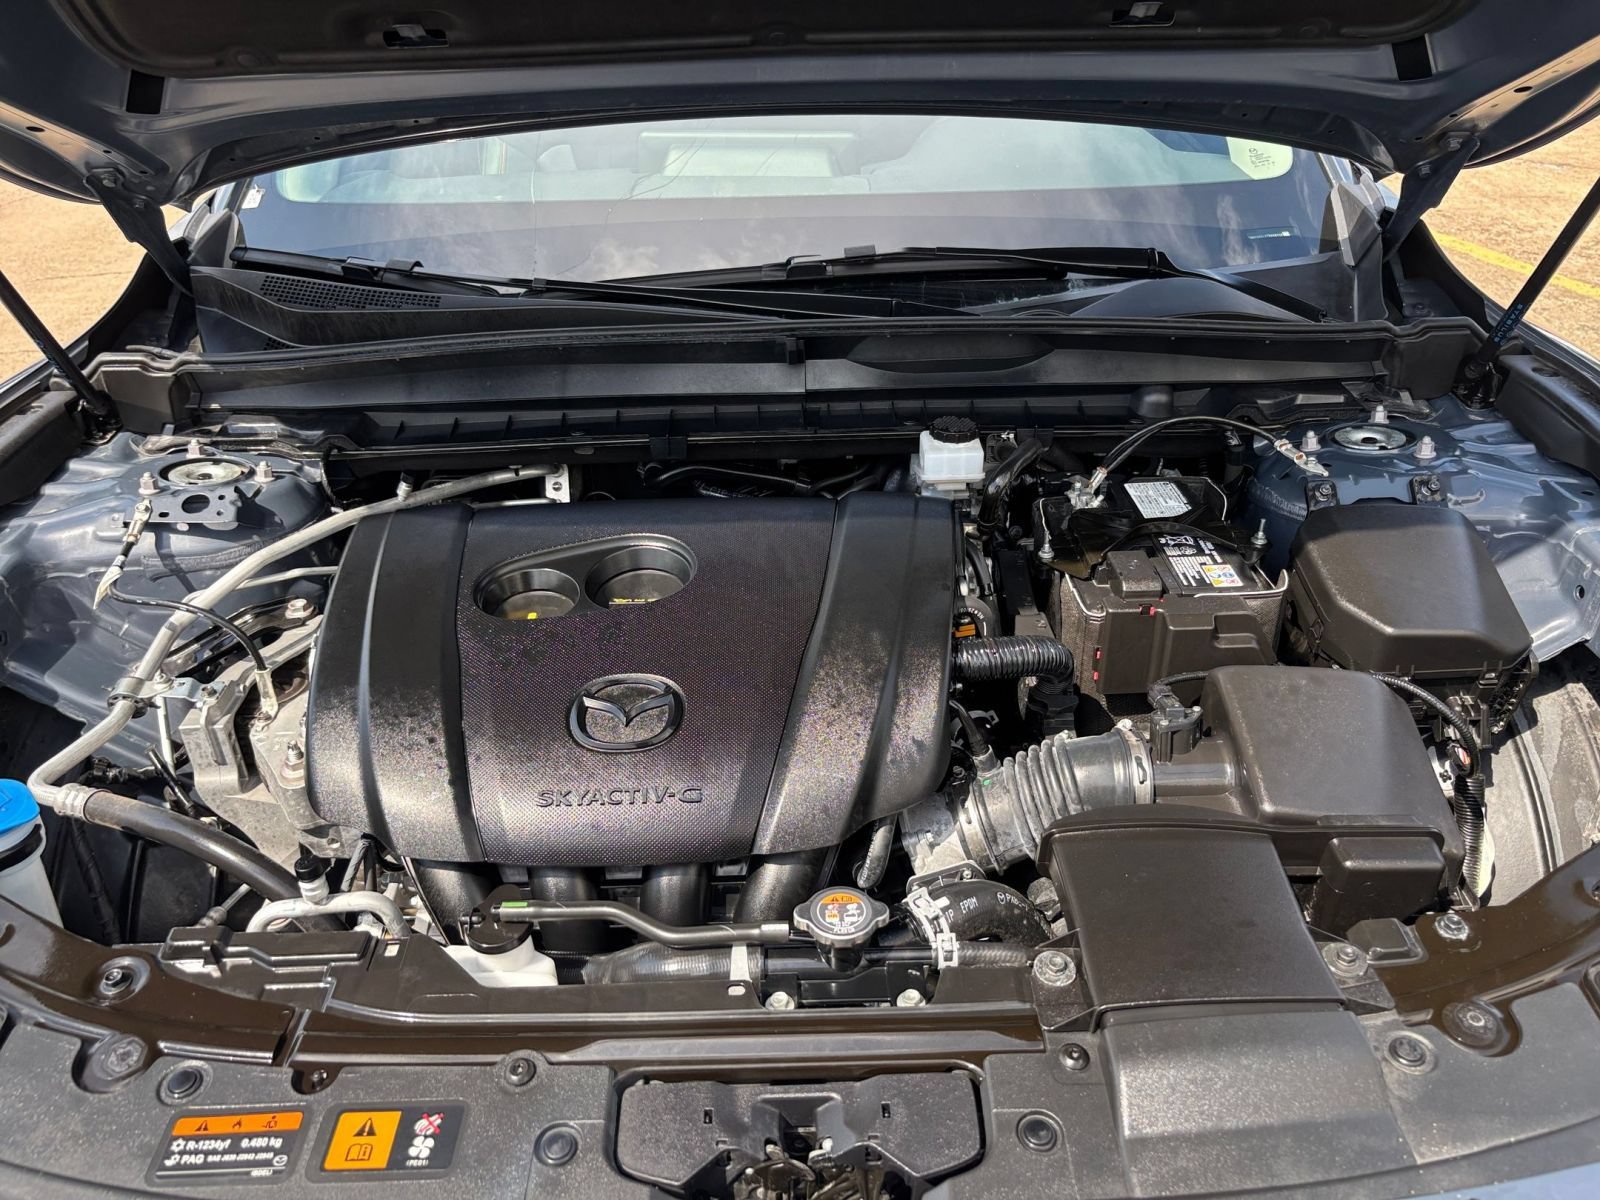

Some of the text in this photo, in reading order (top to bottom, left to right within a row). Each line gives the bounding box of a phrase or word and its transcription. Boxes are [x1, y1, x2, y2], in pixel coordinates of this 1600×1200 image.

[1493, 303, 1524, 343] STABILUS
[536, 786, 703, 807] SKYACTIV-G
[960, 896, 979, 914] EPDM
[186, 1138, 231, 1151] R-1234yf
[269, 1137, 283, 1149] kg
[181, 1153, 205, 1165] PAG
